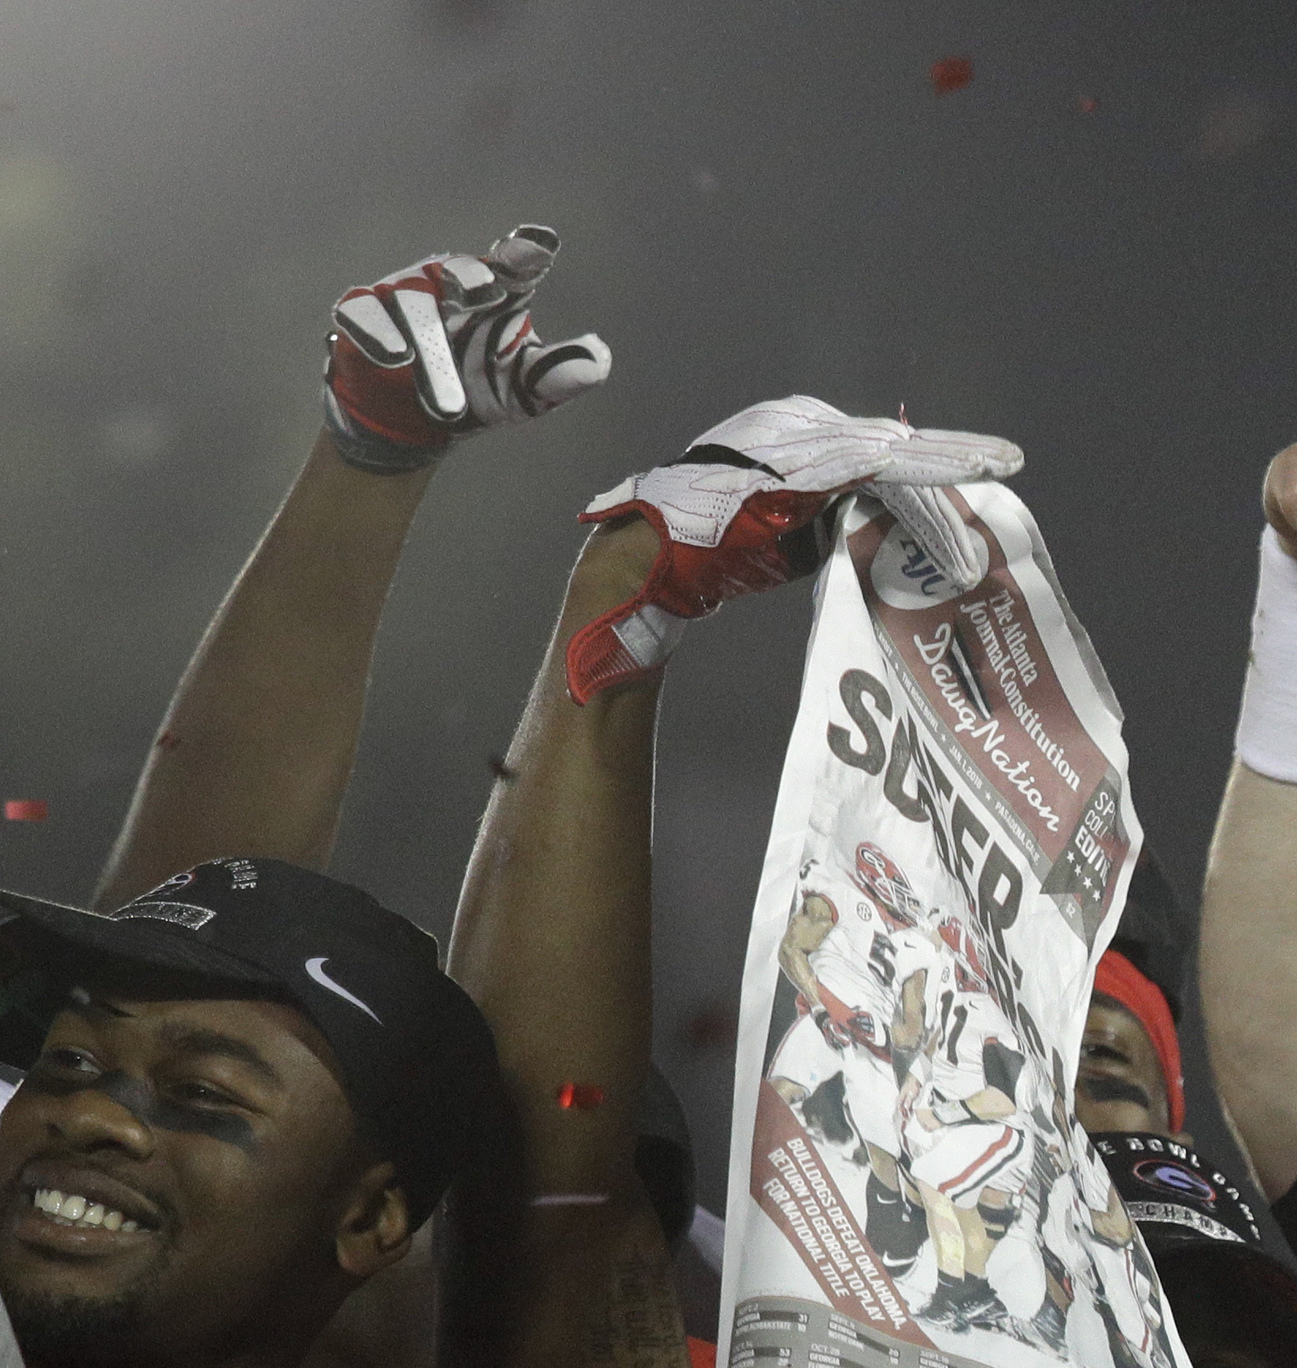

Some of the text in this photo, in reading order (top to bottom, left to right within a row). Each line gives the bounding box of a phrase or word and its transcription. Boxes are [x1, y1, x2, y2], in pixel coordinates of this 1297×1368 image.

[959, 601, 1081, 792] Journal-Constitution
[989, 588, 1038, 688] The Atlanta
[965, 766, 984, 790] 2018
[1126, 1136, 1200, 1168] BOWL
[762, 1177, 850, 1298] FOR NATIONAL TITLE
[767, 1147, 886, 1321] RETURN TO GEORGIA TO PLAY
[786, 1137, 836, 1208] BULLDOGS
[827, 1206, 866, 1255] DEFEAT
[855, 1254, 908, 1330] OKLAHOMA
